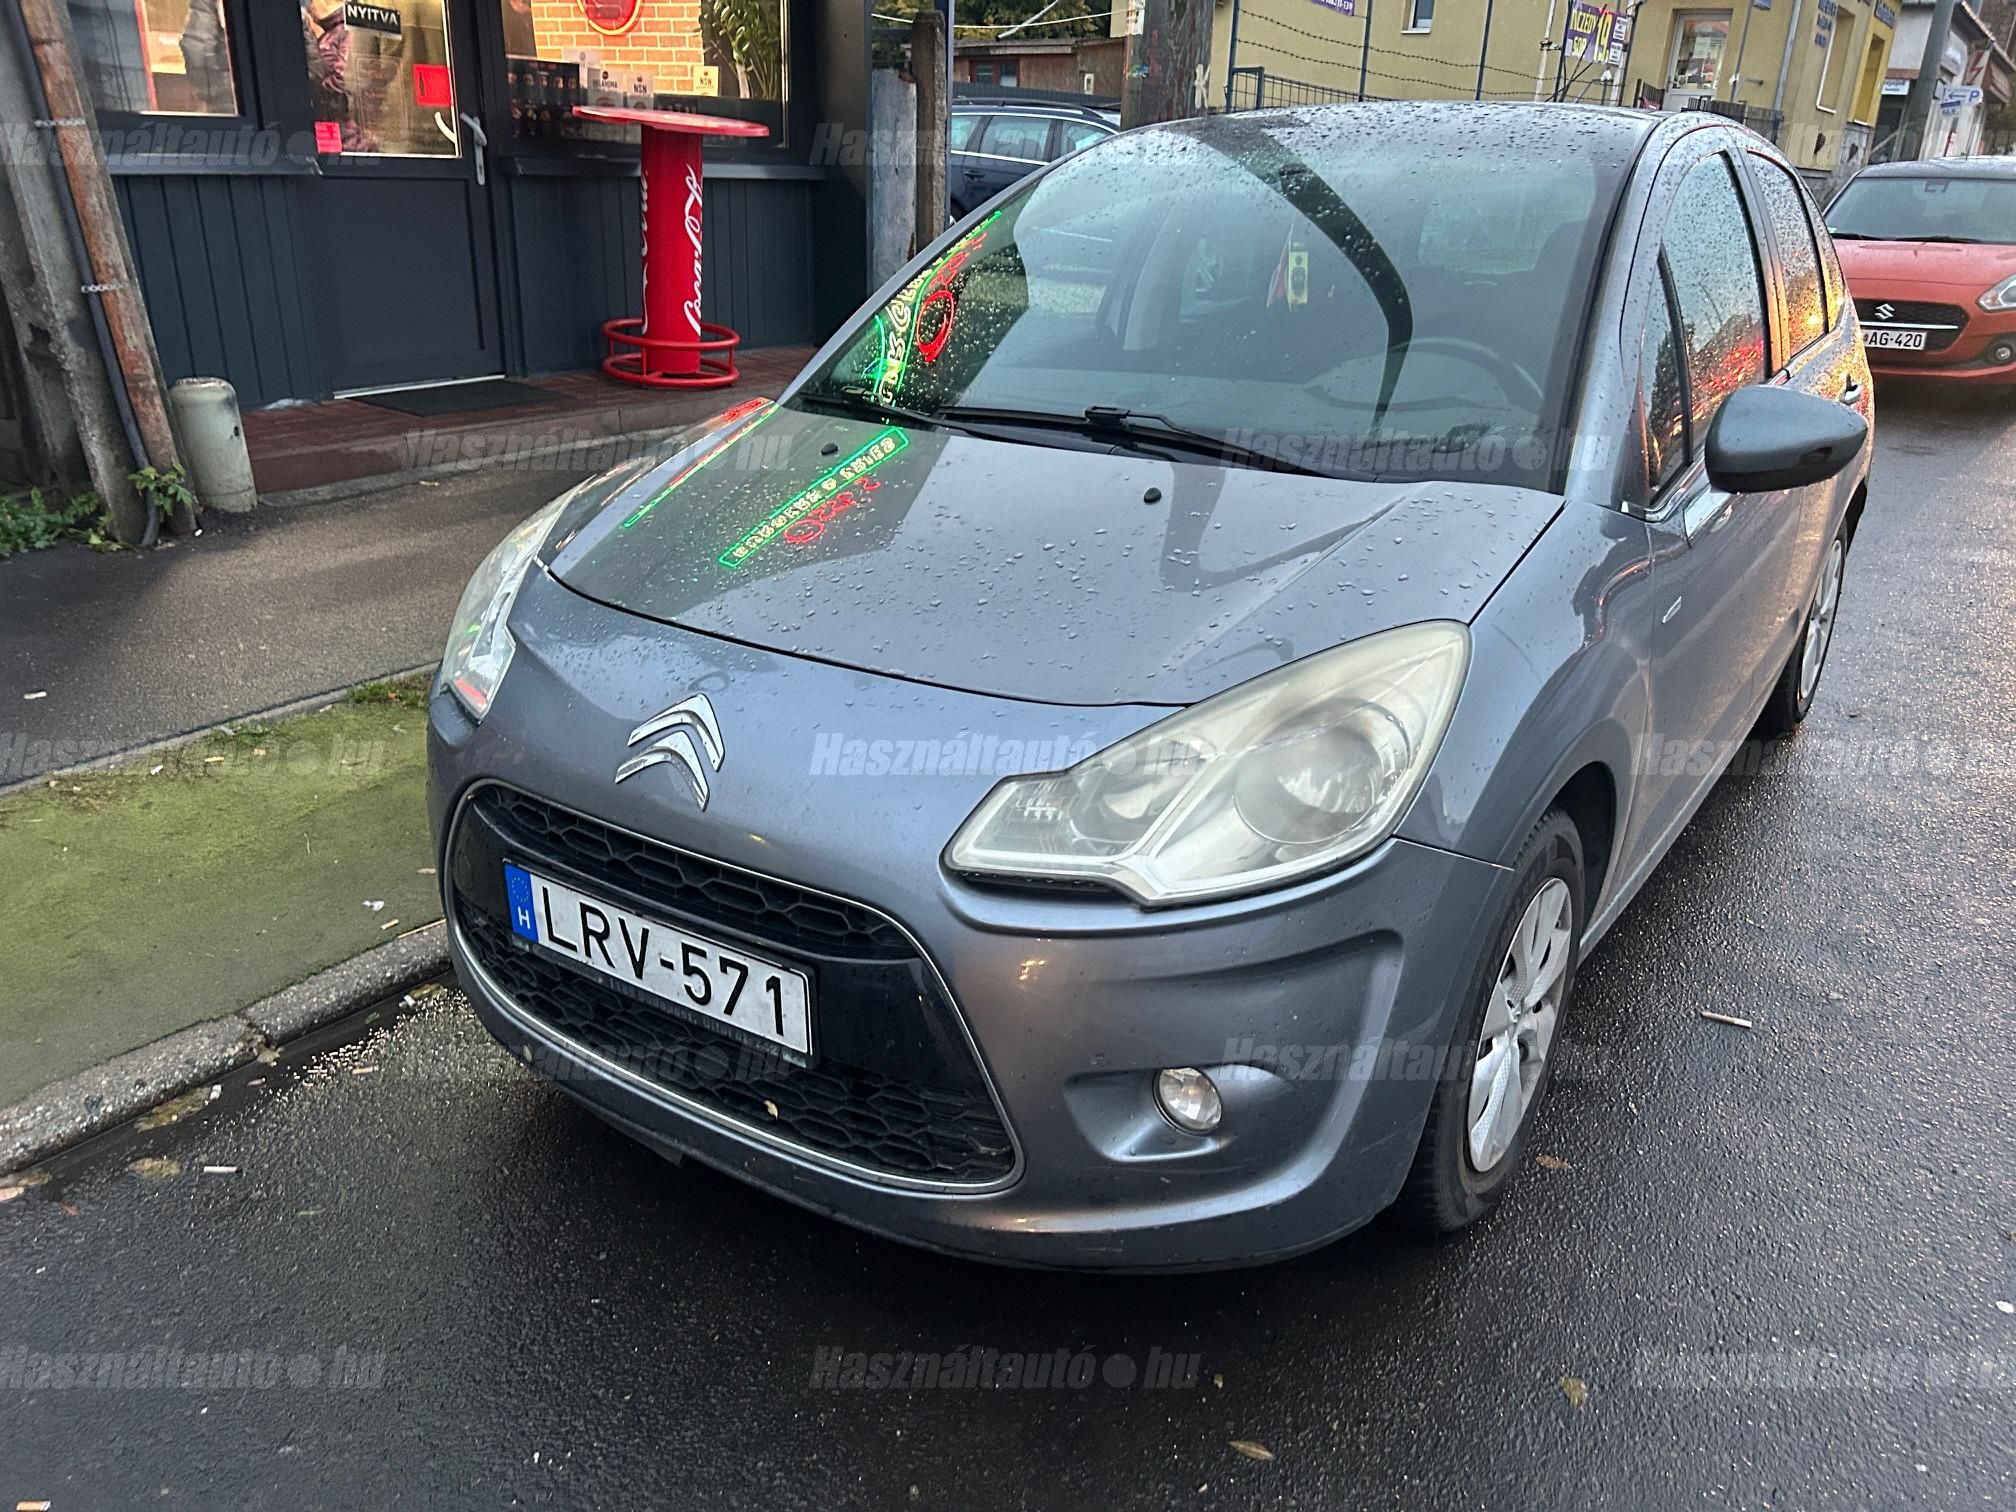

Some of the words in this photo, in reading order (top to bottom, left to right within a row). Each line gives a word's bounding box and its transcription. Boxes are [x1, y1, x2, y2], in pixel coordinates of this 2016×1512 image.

[347, 4, 398, 26] NYITVA
[1969, 90, 1980, 102] P
[1868, 331, 1923, 348] AG-420
[516, 906, 531, 930] H
[542, 885, 785, 1037] LRV-571
